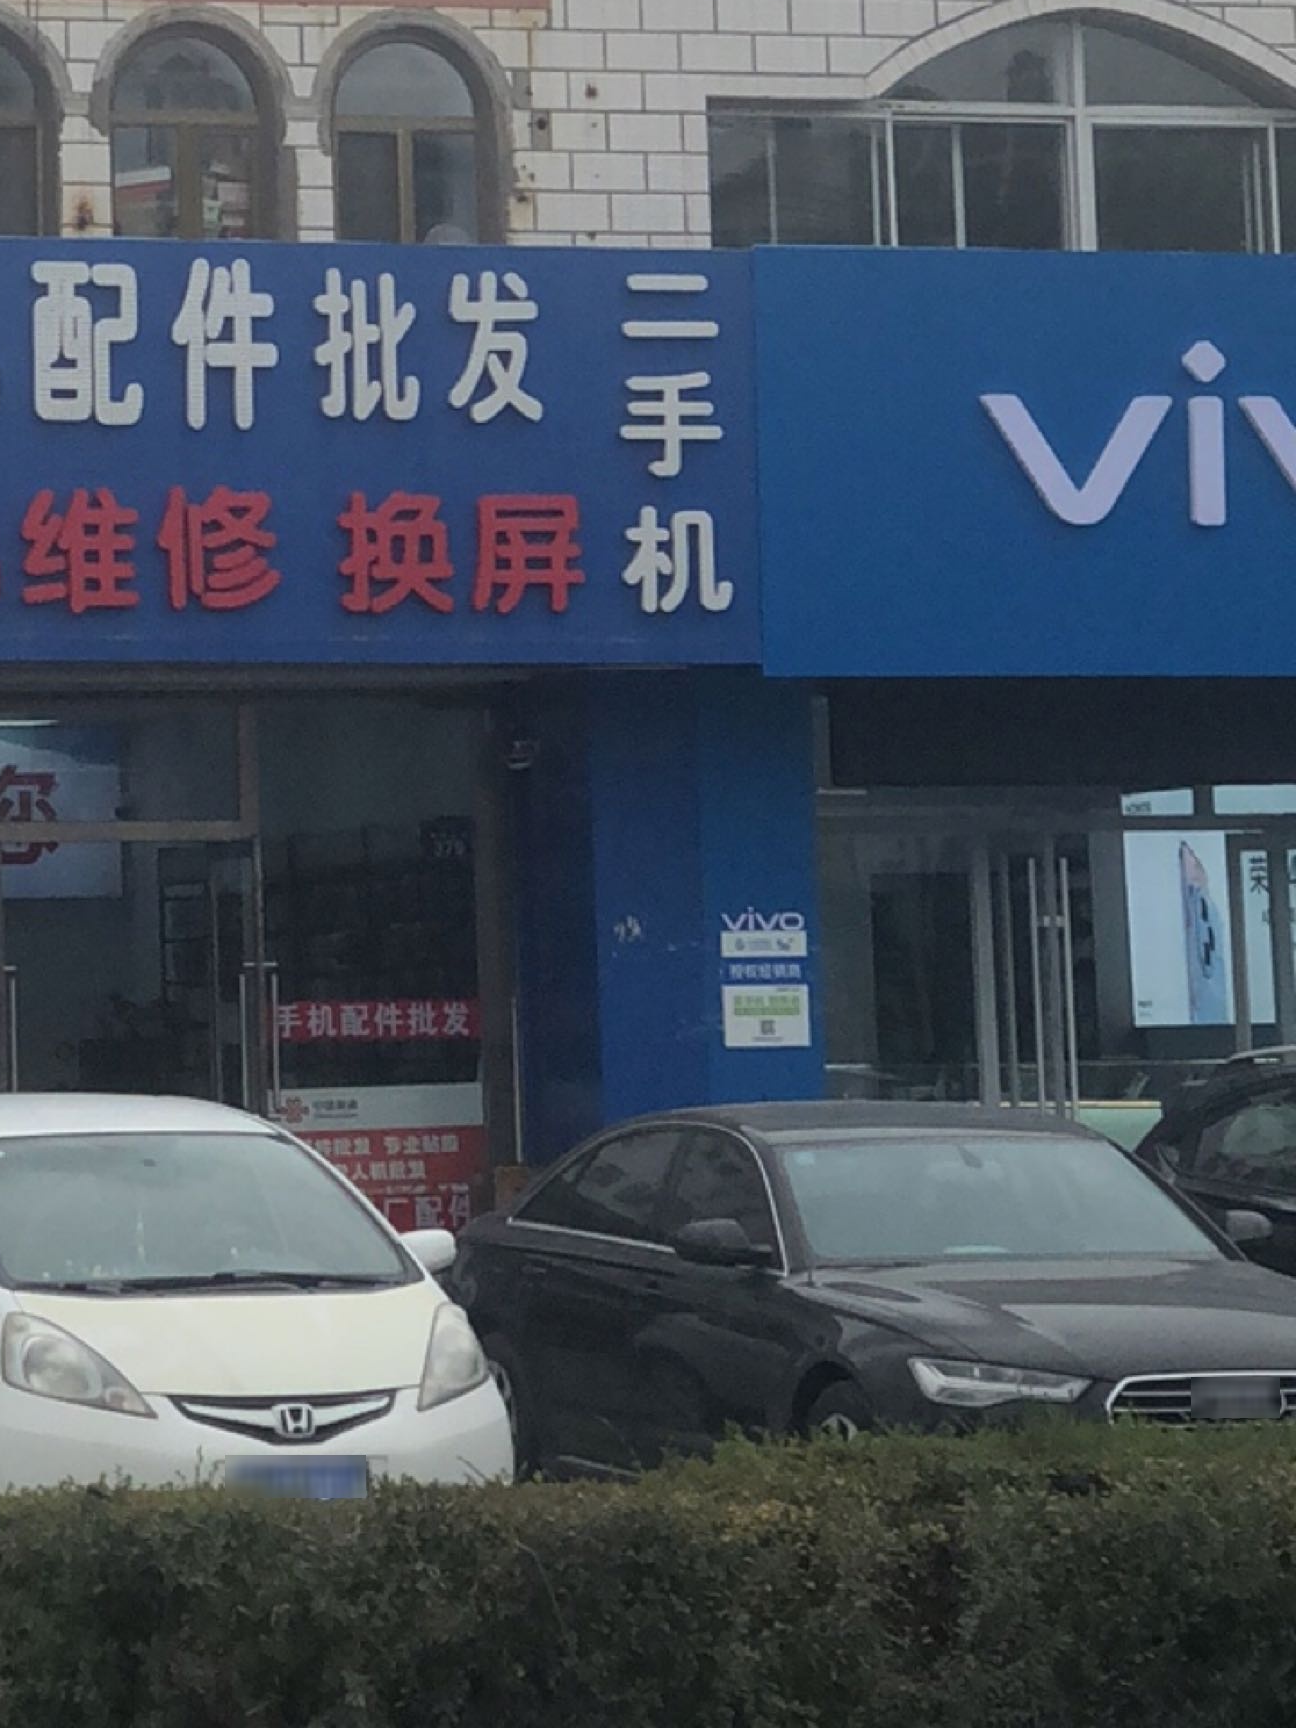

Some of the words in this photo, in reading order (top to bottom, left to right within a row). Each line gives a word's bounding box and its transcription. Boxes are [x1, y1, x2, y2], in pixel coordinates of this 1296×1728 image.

[620, 273, 733, 614] 二手机
[337, 490, 585, 614] 换屏
[721, 906, 806, 931] vivo
[277, 1001, 471, 1038] 手机配件批发
